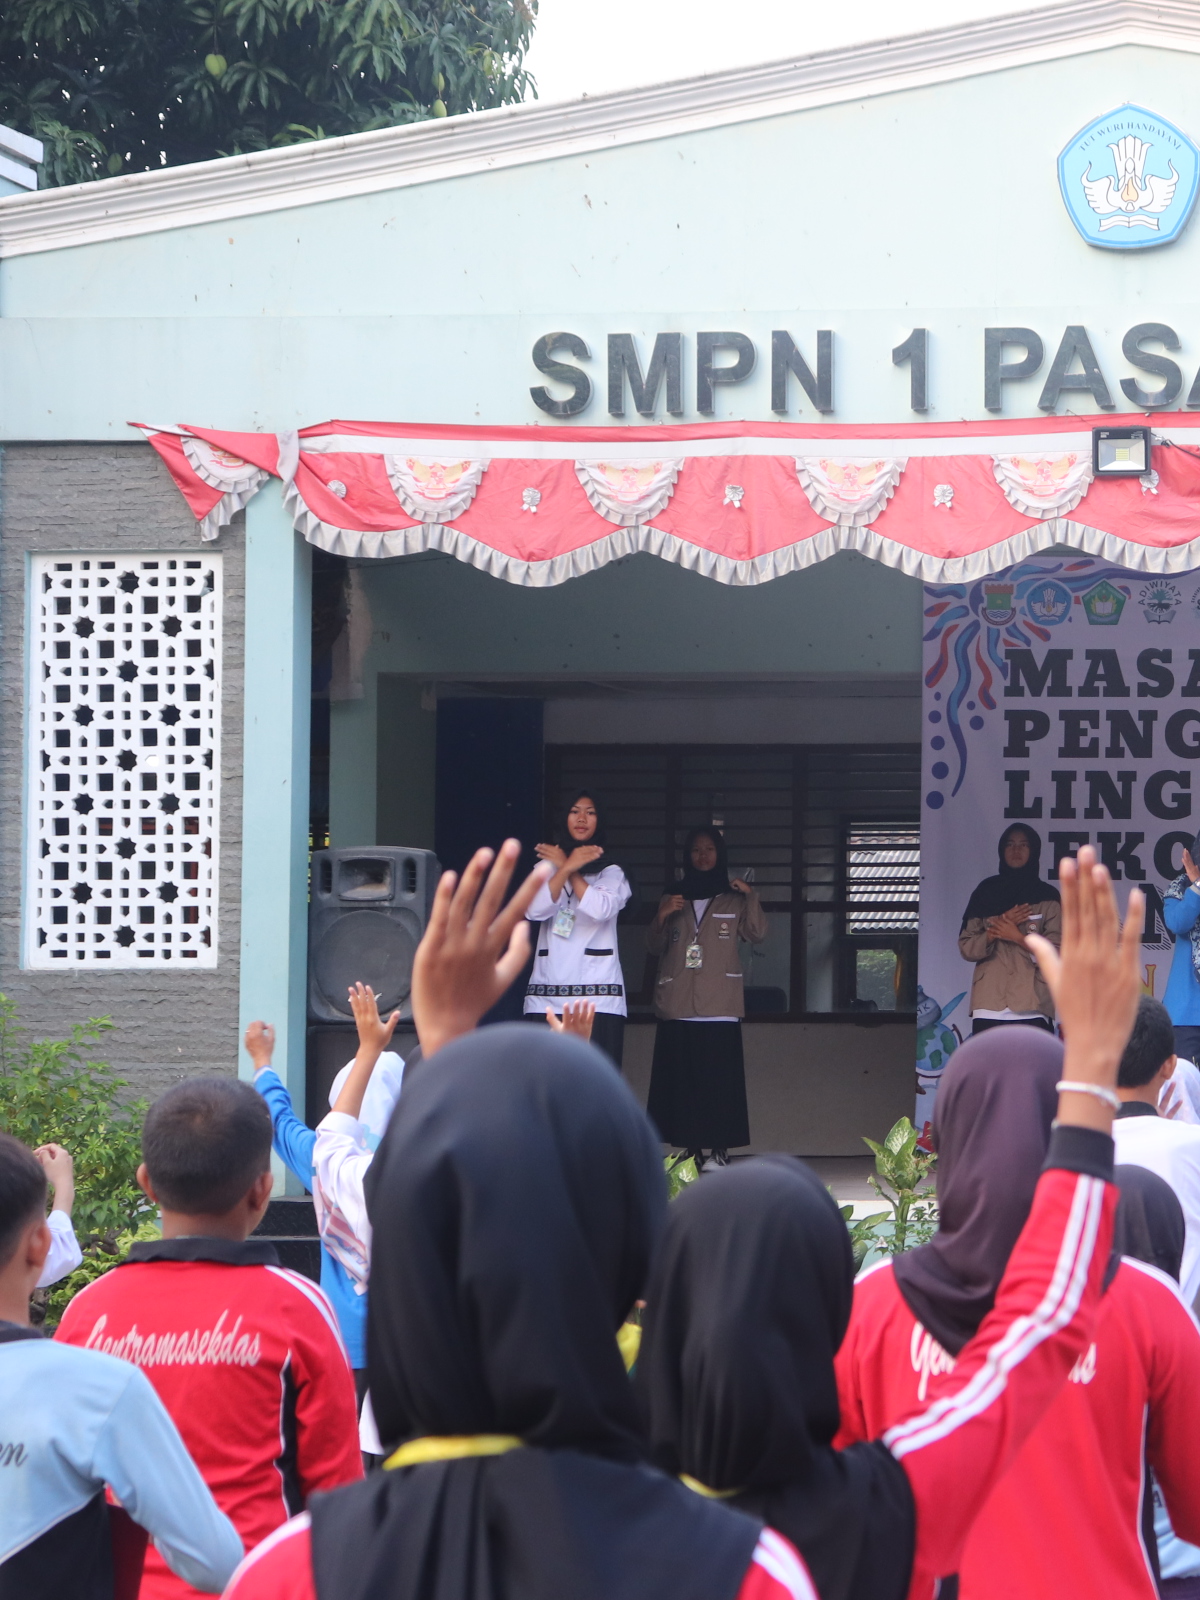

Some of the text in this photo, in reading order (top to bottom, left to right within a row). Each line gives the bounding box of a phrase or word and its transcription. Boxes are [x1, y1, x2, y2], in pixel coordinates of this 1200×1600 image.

[1079, 122, 1182, 151] TUT WURI HANDAYANI
[529, 330, 834, 417] SMPN
[892, 328, 930, 412] 1
[1138, 580, 1182, 606] ADIWIYATA
